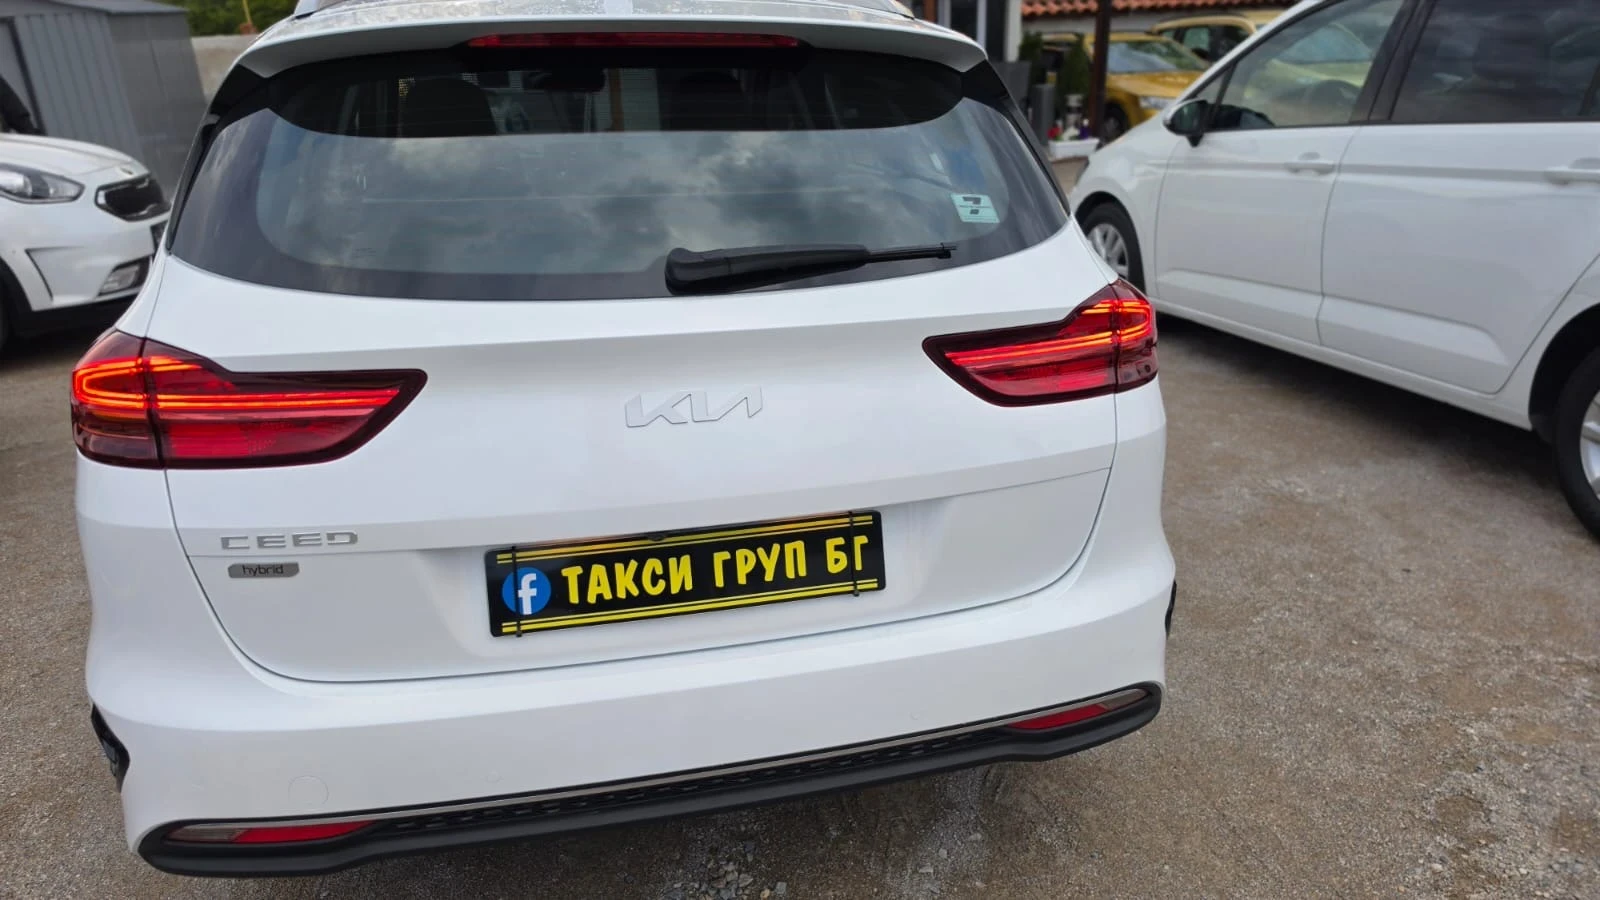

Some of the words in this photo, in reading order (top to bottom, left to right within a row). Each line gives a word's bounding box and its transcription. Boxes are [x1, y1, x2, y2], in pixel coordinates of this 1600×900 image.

[625, 385, 763, 428] KIA
[221, 532, 358, 549] CEED
[242, 564, 284, 577] hybrid
[561, 555, 693, 604] ТАКСИ
[713, 540, 807, 588] ГРУП
[825, 535, 869, 574] БГ
